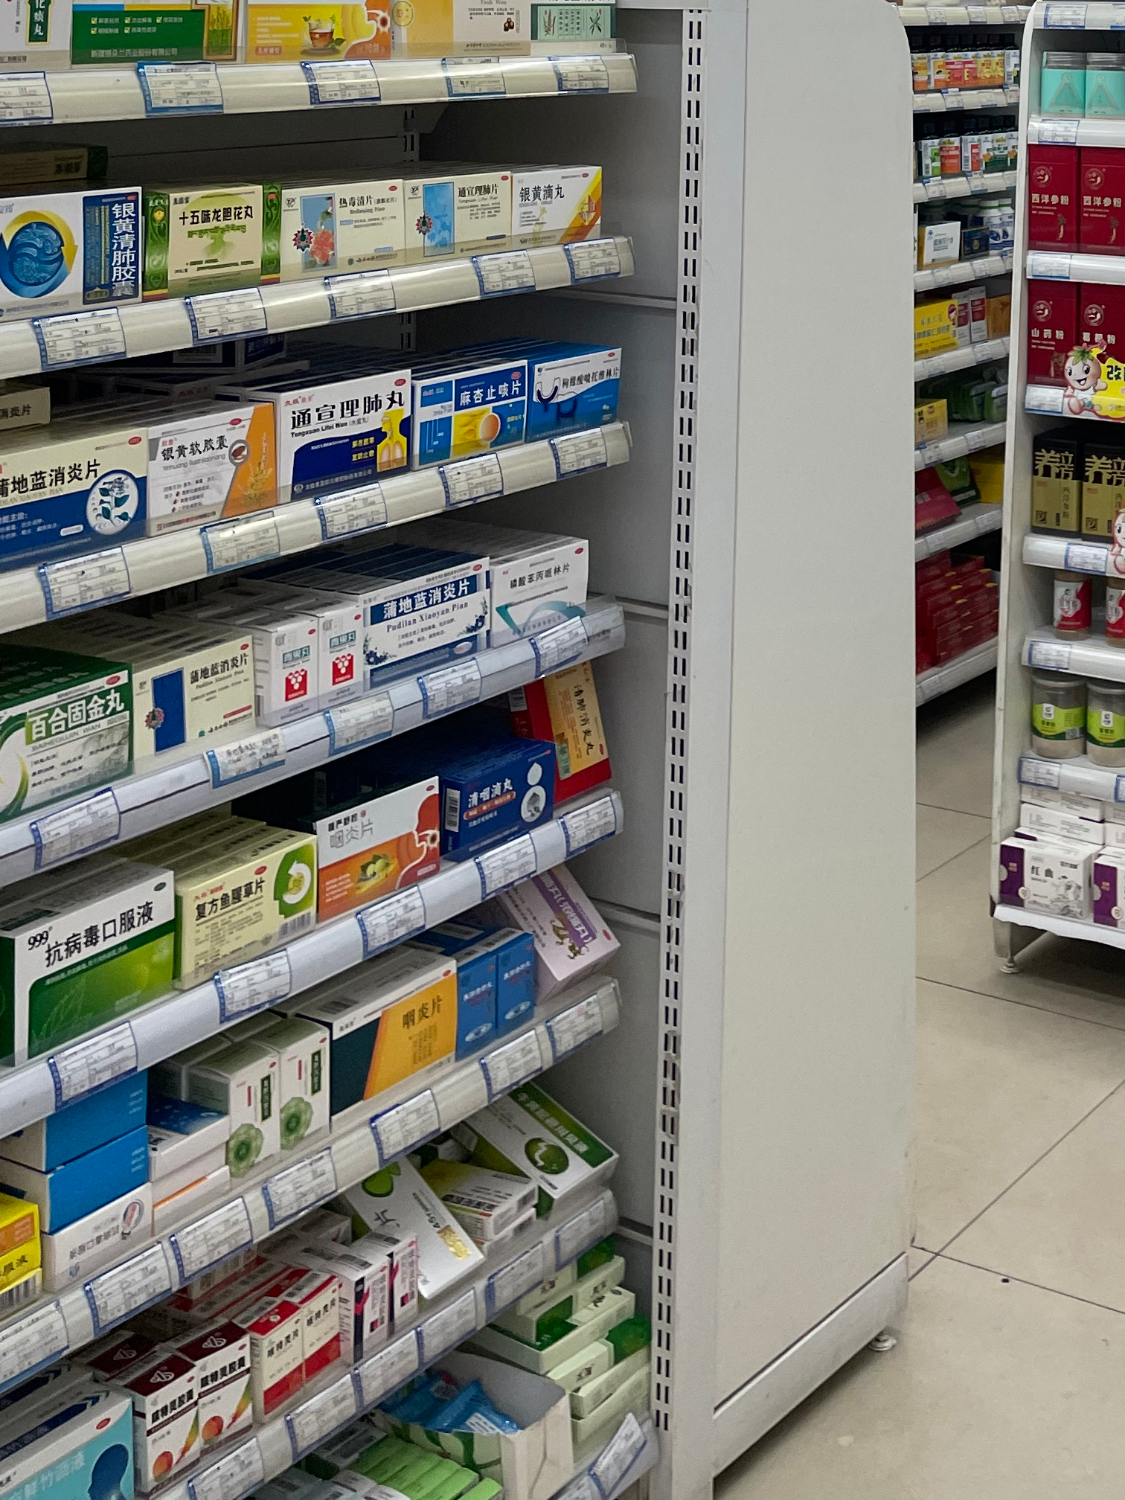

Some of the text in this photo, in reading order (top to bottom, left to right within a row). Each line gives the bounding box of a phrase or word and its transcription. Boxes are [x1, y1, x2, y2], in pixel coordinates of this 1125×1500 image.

[457, 183, 499, 198] 通宣理肺片
[519, 184, 565, 203] 银黄滴丸
[1031, 193, 1070, 206] 西洋参粉
[1083, 195, 1122, 208] 西洋参粉
[178, 205, 255, 227] 十五味龙胆花丸
[111, 203, 137, 297] 银黄清肺胶囊
[562, 366, 621, 389] 枸橼酸喷托维林片
[459, 380, 523, 407] 麻杏止咳片
[290, 390, 406, 431] 通宣理肺丸
[161, 435, 229, 461] 银黄软胶囊
[510, 563, 570, 590] 磷酸苯丙哌林片
[383, 578, 471, 619] 蒲地蓝消炎片
[419, 607, 450, 626] Xiaoyan
[452, 601, 469, 614] Pian
[189, 652, 250, 685] 蒲地蓝消炎片
[28, 688, 126, 740] 百合固金丸
[468, 777, 514, 808] 清咽滴丸
[330, 818, 374, 849] 咽炎片
[1030, 864, 1054, 879] 红曲
[195, 877, 266, 921] 复方鱼腥草片
[27, 929, 49, 951] 999
[45, 901, 154, 968] 抗病毒口服液
[402, 995, 443, 1029] 咽炎片
